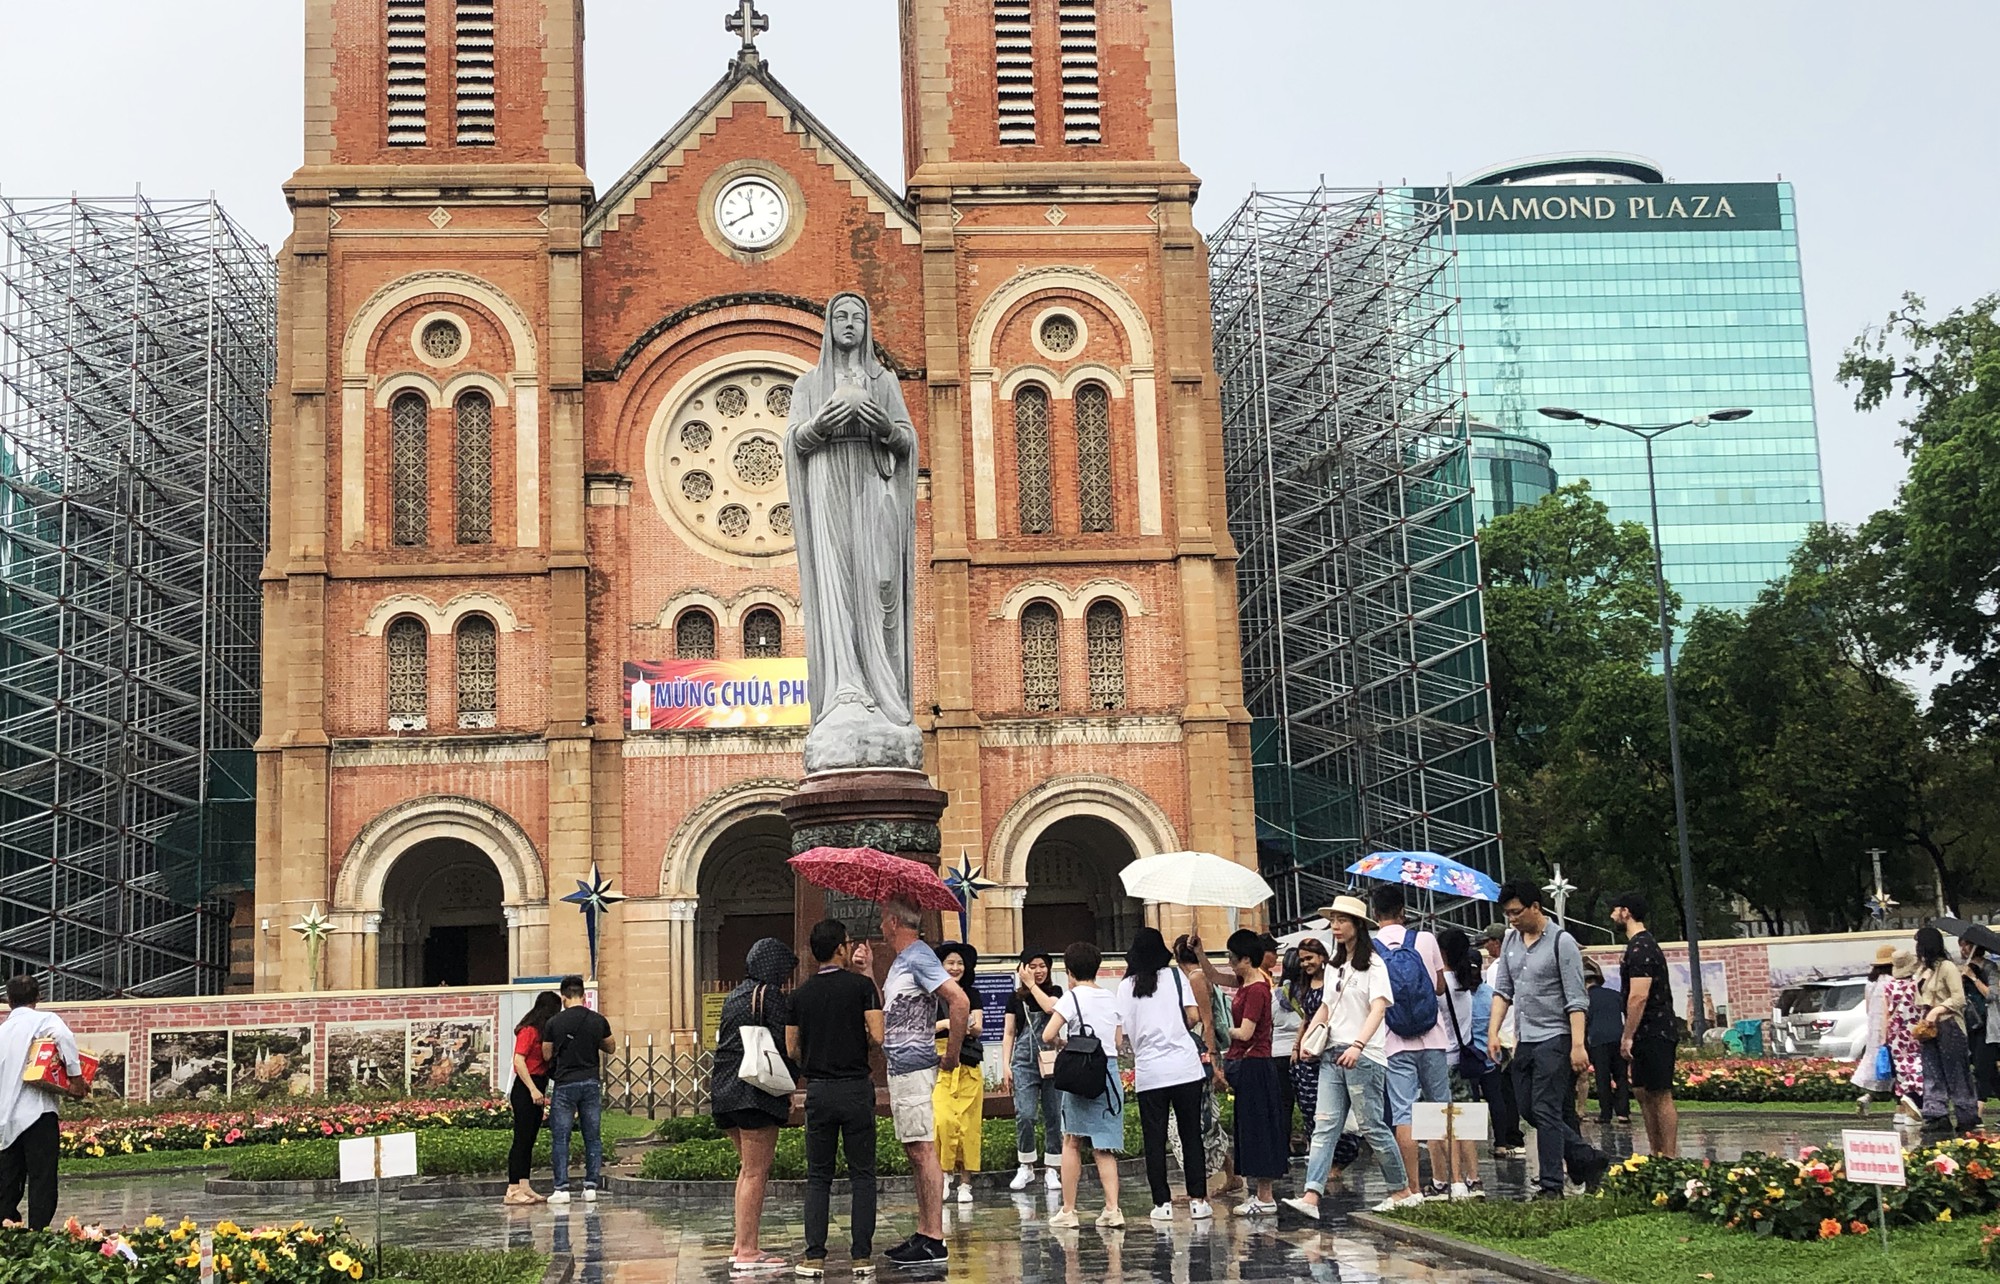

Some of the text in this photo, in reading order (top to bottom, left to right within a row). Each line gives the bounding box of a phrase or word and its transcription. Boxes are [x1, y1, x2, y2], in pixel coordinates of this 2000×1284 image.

[1453, 194, 1736, 222] DIAMOND PLAZA
[655, 675, 811, 708] MỪNG CHÚA PH
